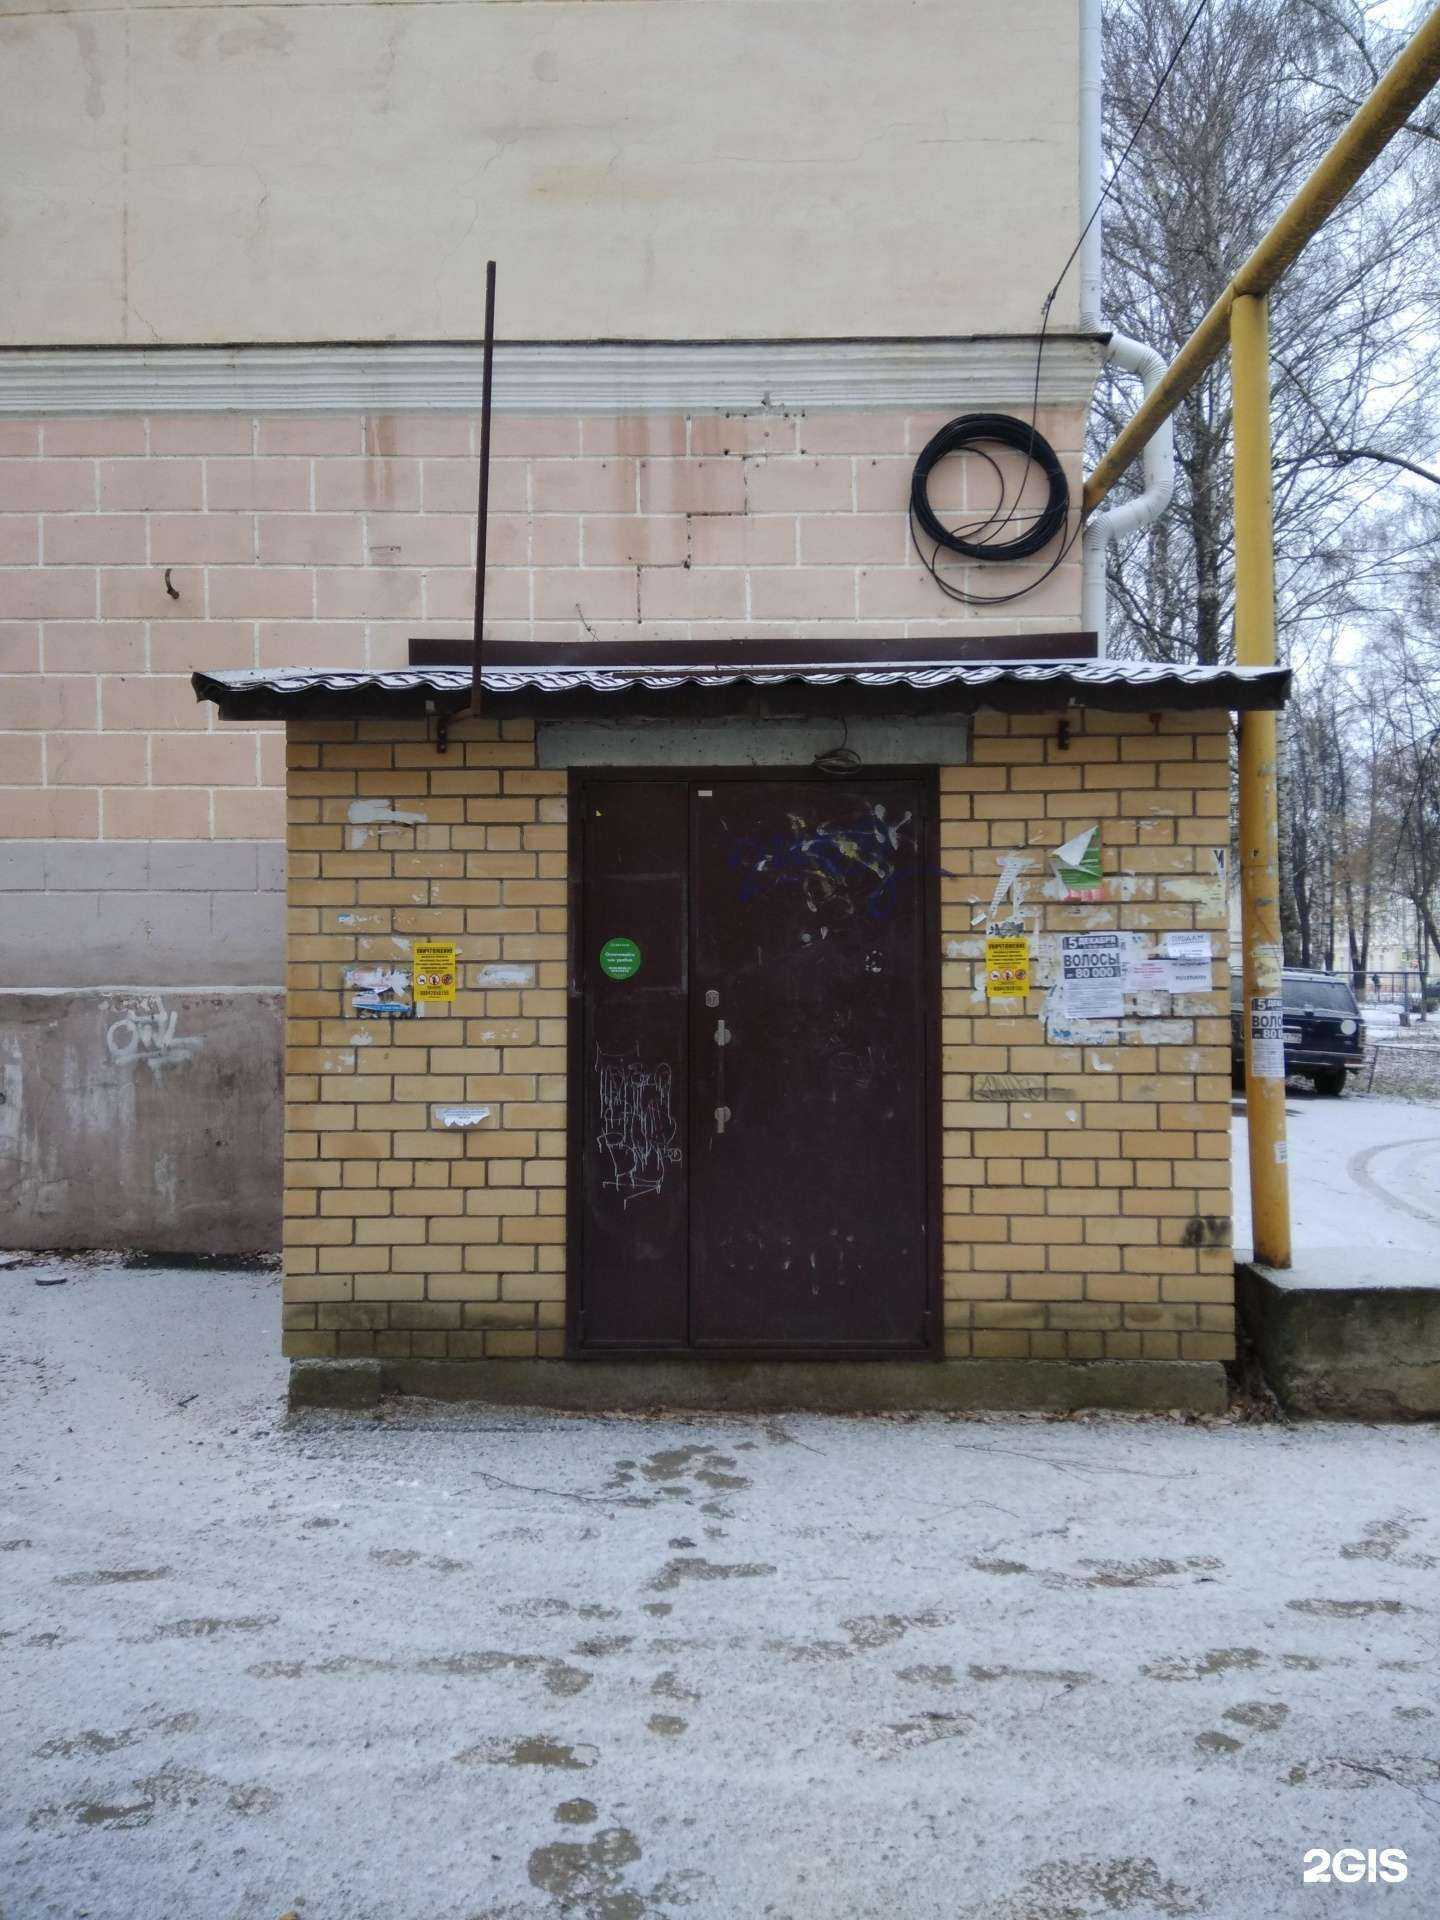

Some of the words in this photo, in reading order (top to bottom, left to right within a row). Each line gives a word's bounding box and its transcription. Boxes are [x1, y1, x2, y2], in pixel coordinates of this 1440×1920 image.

[1069, 937, 1078, 949] 5
[1064, 952, 1120, 967] ВОЛОСЫ
[1075, 968, 1090, 978] 80
[1092, 967, 1114, 978] 000
[1258, 999, 1266, 1010] 5
